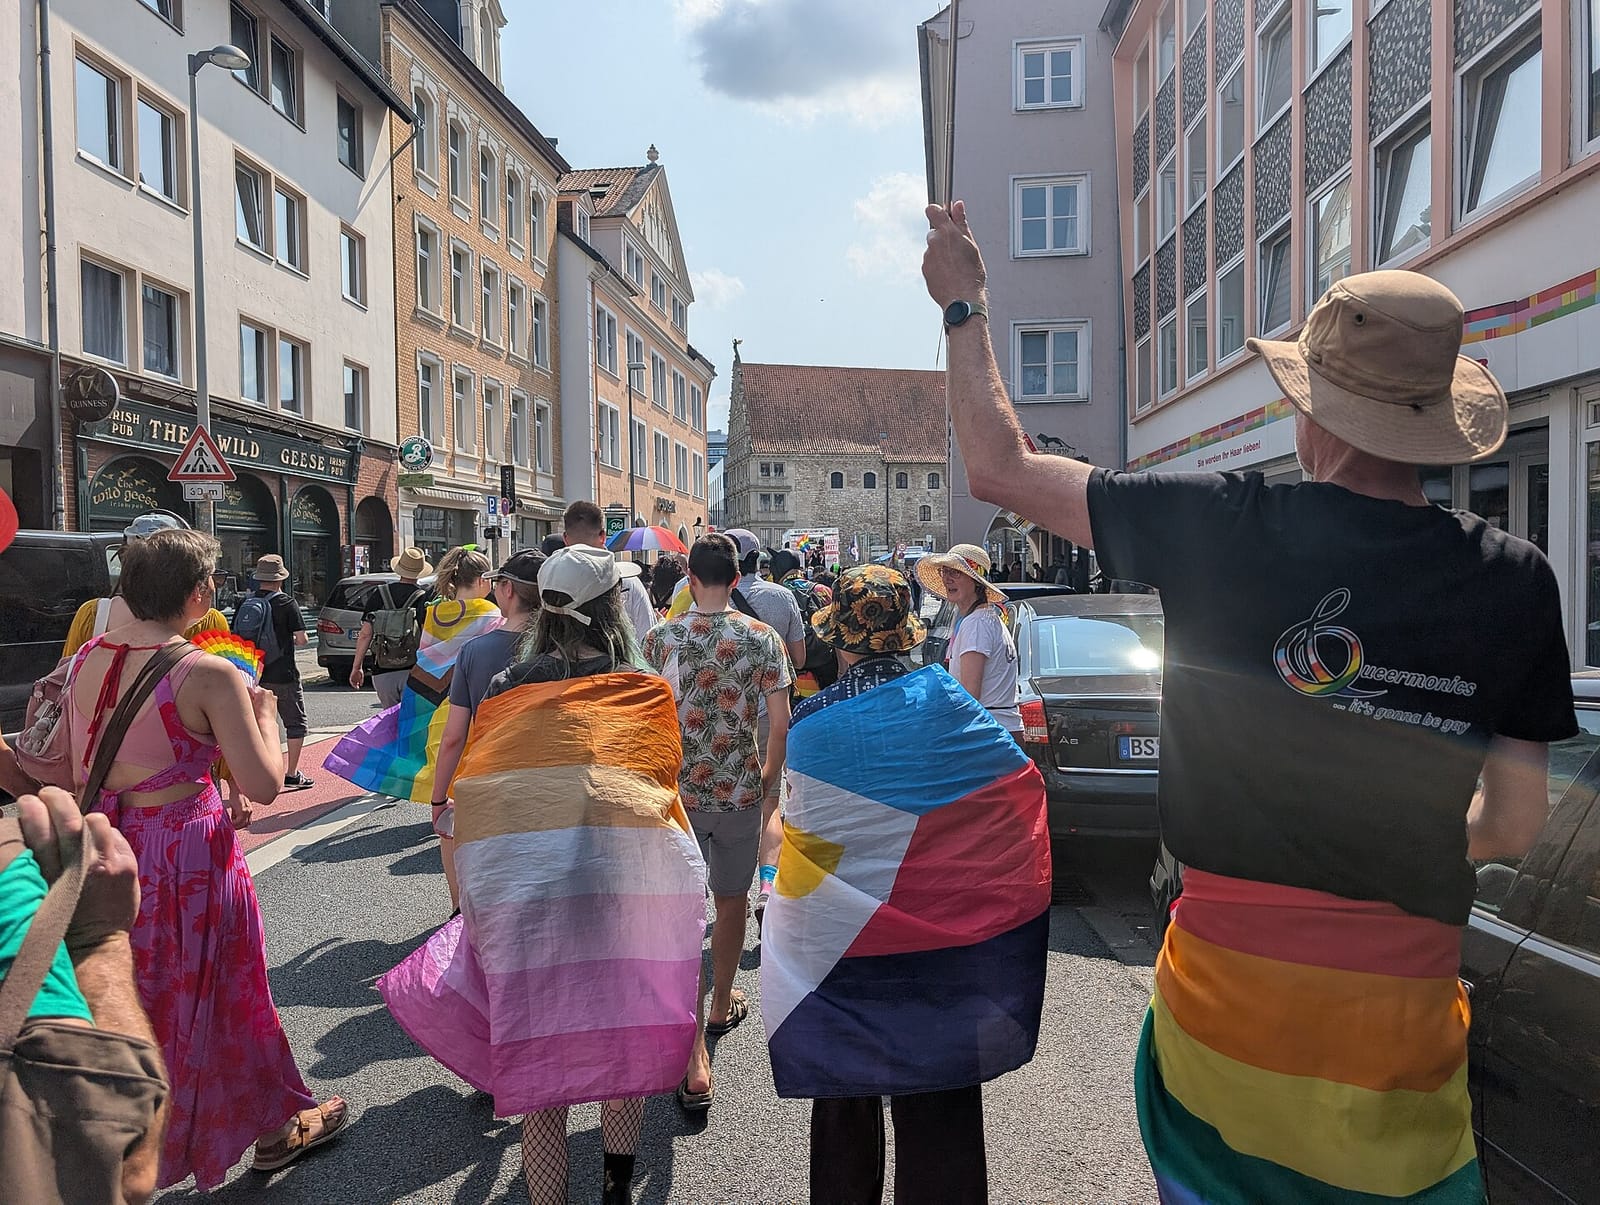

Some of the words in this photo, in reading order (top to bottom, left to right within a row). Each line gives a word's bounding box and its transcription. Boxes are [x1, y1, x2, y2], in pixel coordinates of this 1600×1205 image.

[71, 399, 108, 409] GUINNESS
[109, 410, 140, 425] RISH
[111, 422, 134, 437] PUB
[149, 418, 190, 445] THE
[217, 434, 260, 459] WILD
[281, 448, 325, 471] GEESE
[1230, 448, 1242, 456] Haar
[330, 457, 346, 466] IRISH
[331, 467, 343, 476] PUB
[93, 486, 121, 505] wild
[124, 490, 159, 510] geese
[1374, 705, 1421, 725] gonna
[1422, 712, 1441, 728] be
[1441, 717, 1471, 735] gay
[1131, 738, 1155, 756] BS
